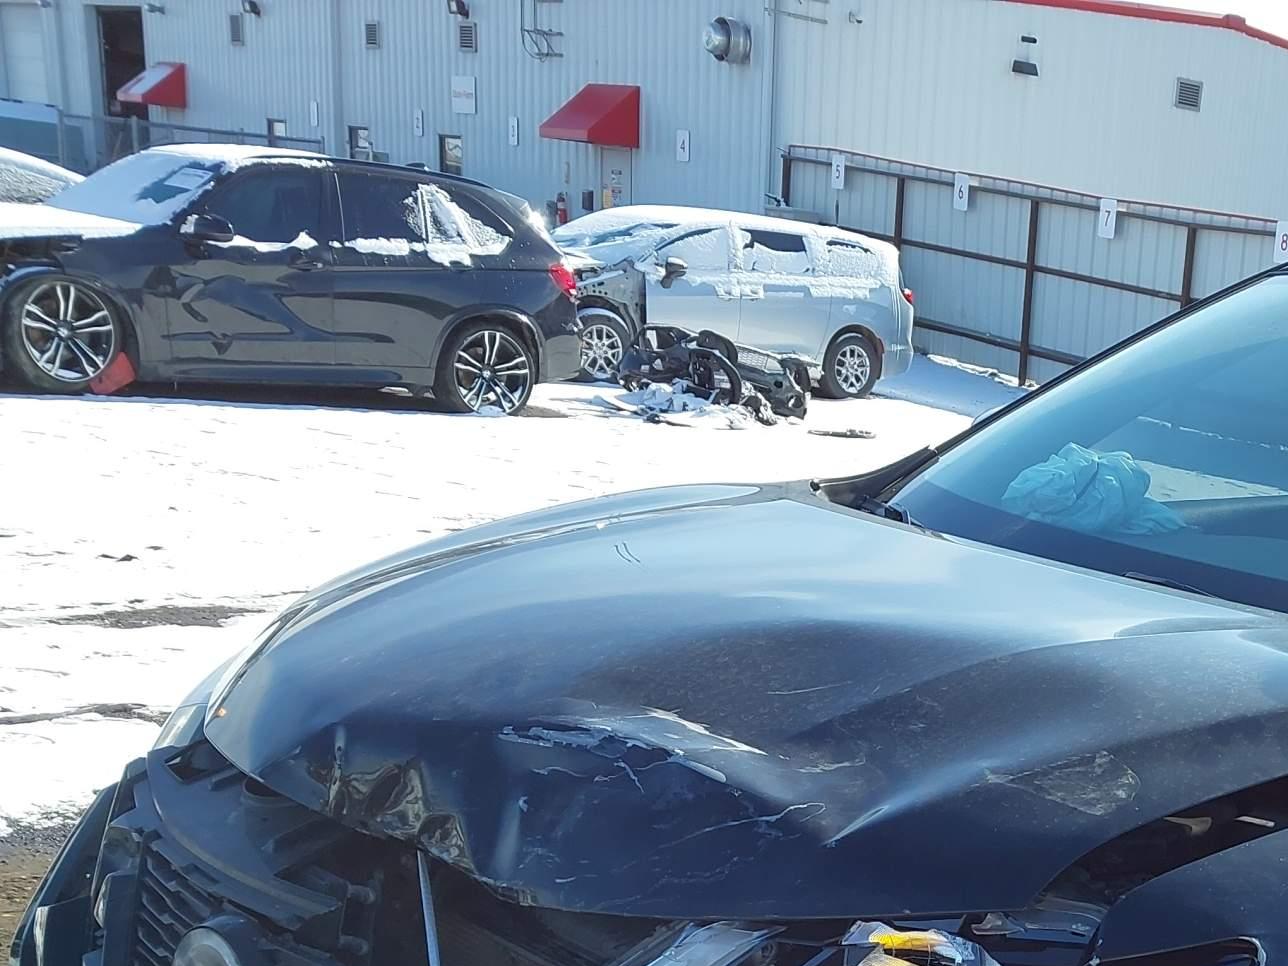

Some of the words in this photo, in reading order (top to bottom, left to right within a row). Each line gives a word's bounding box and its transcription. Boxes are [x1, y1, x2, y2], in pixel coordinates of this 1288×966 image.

[680, 138, 686, 153] 4
[835, 164, 841, 180] 5
[958, 184, 964, 200] 6
[1104, 210, 1111, 227] 7
[1280, 233, 1288, 251] 8
